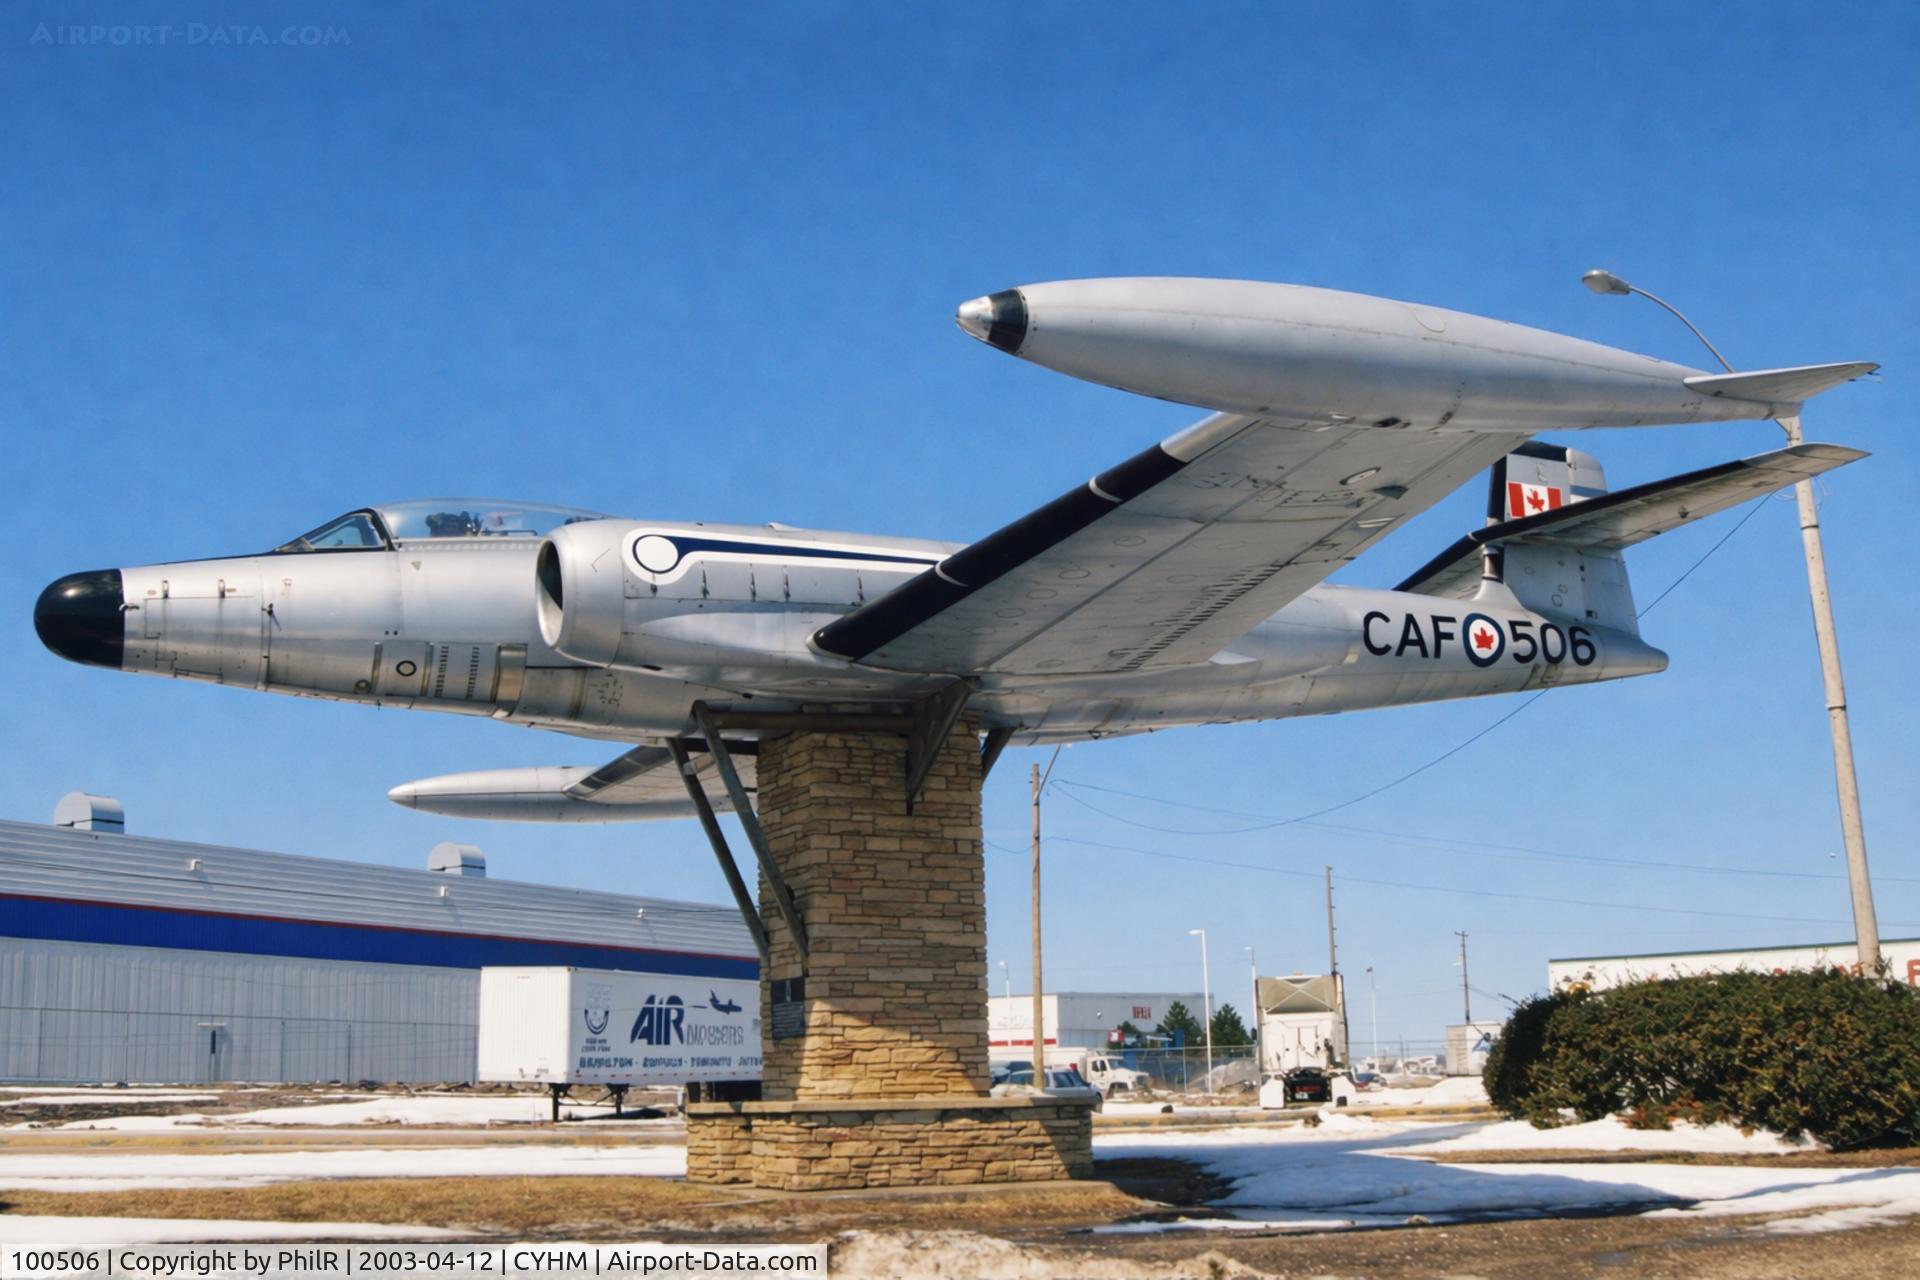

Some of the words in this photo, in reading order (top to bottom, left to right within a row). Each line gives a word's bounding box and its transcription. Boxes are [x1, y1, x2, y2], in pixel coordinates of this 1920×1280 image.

[1363, 611, 1457, 659] CAF
[1508, 620, 1597, 667] 506
[630, 994, 685, 1046] AIR
